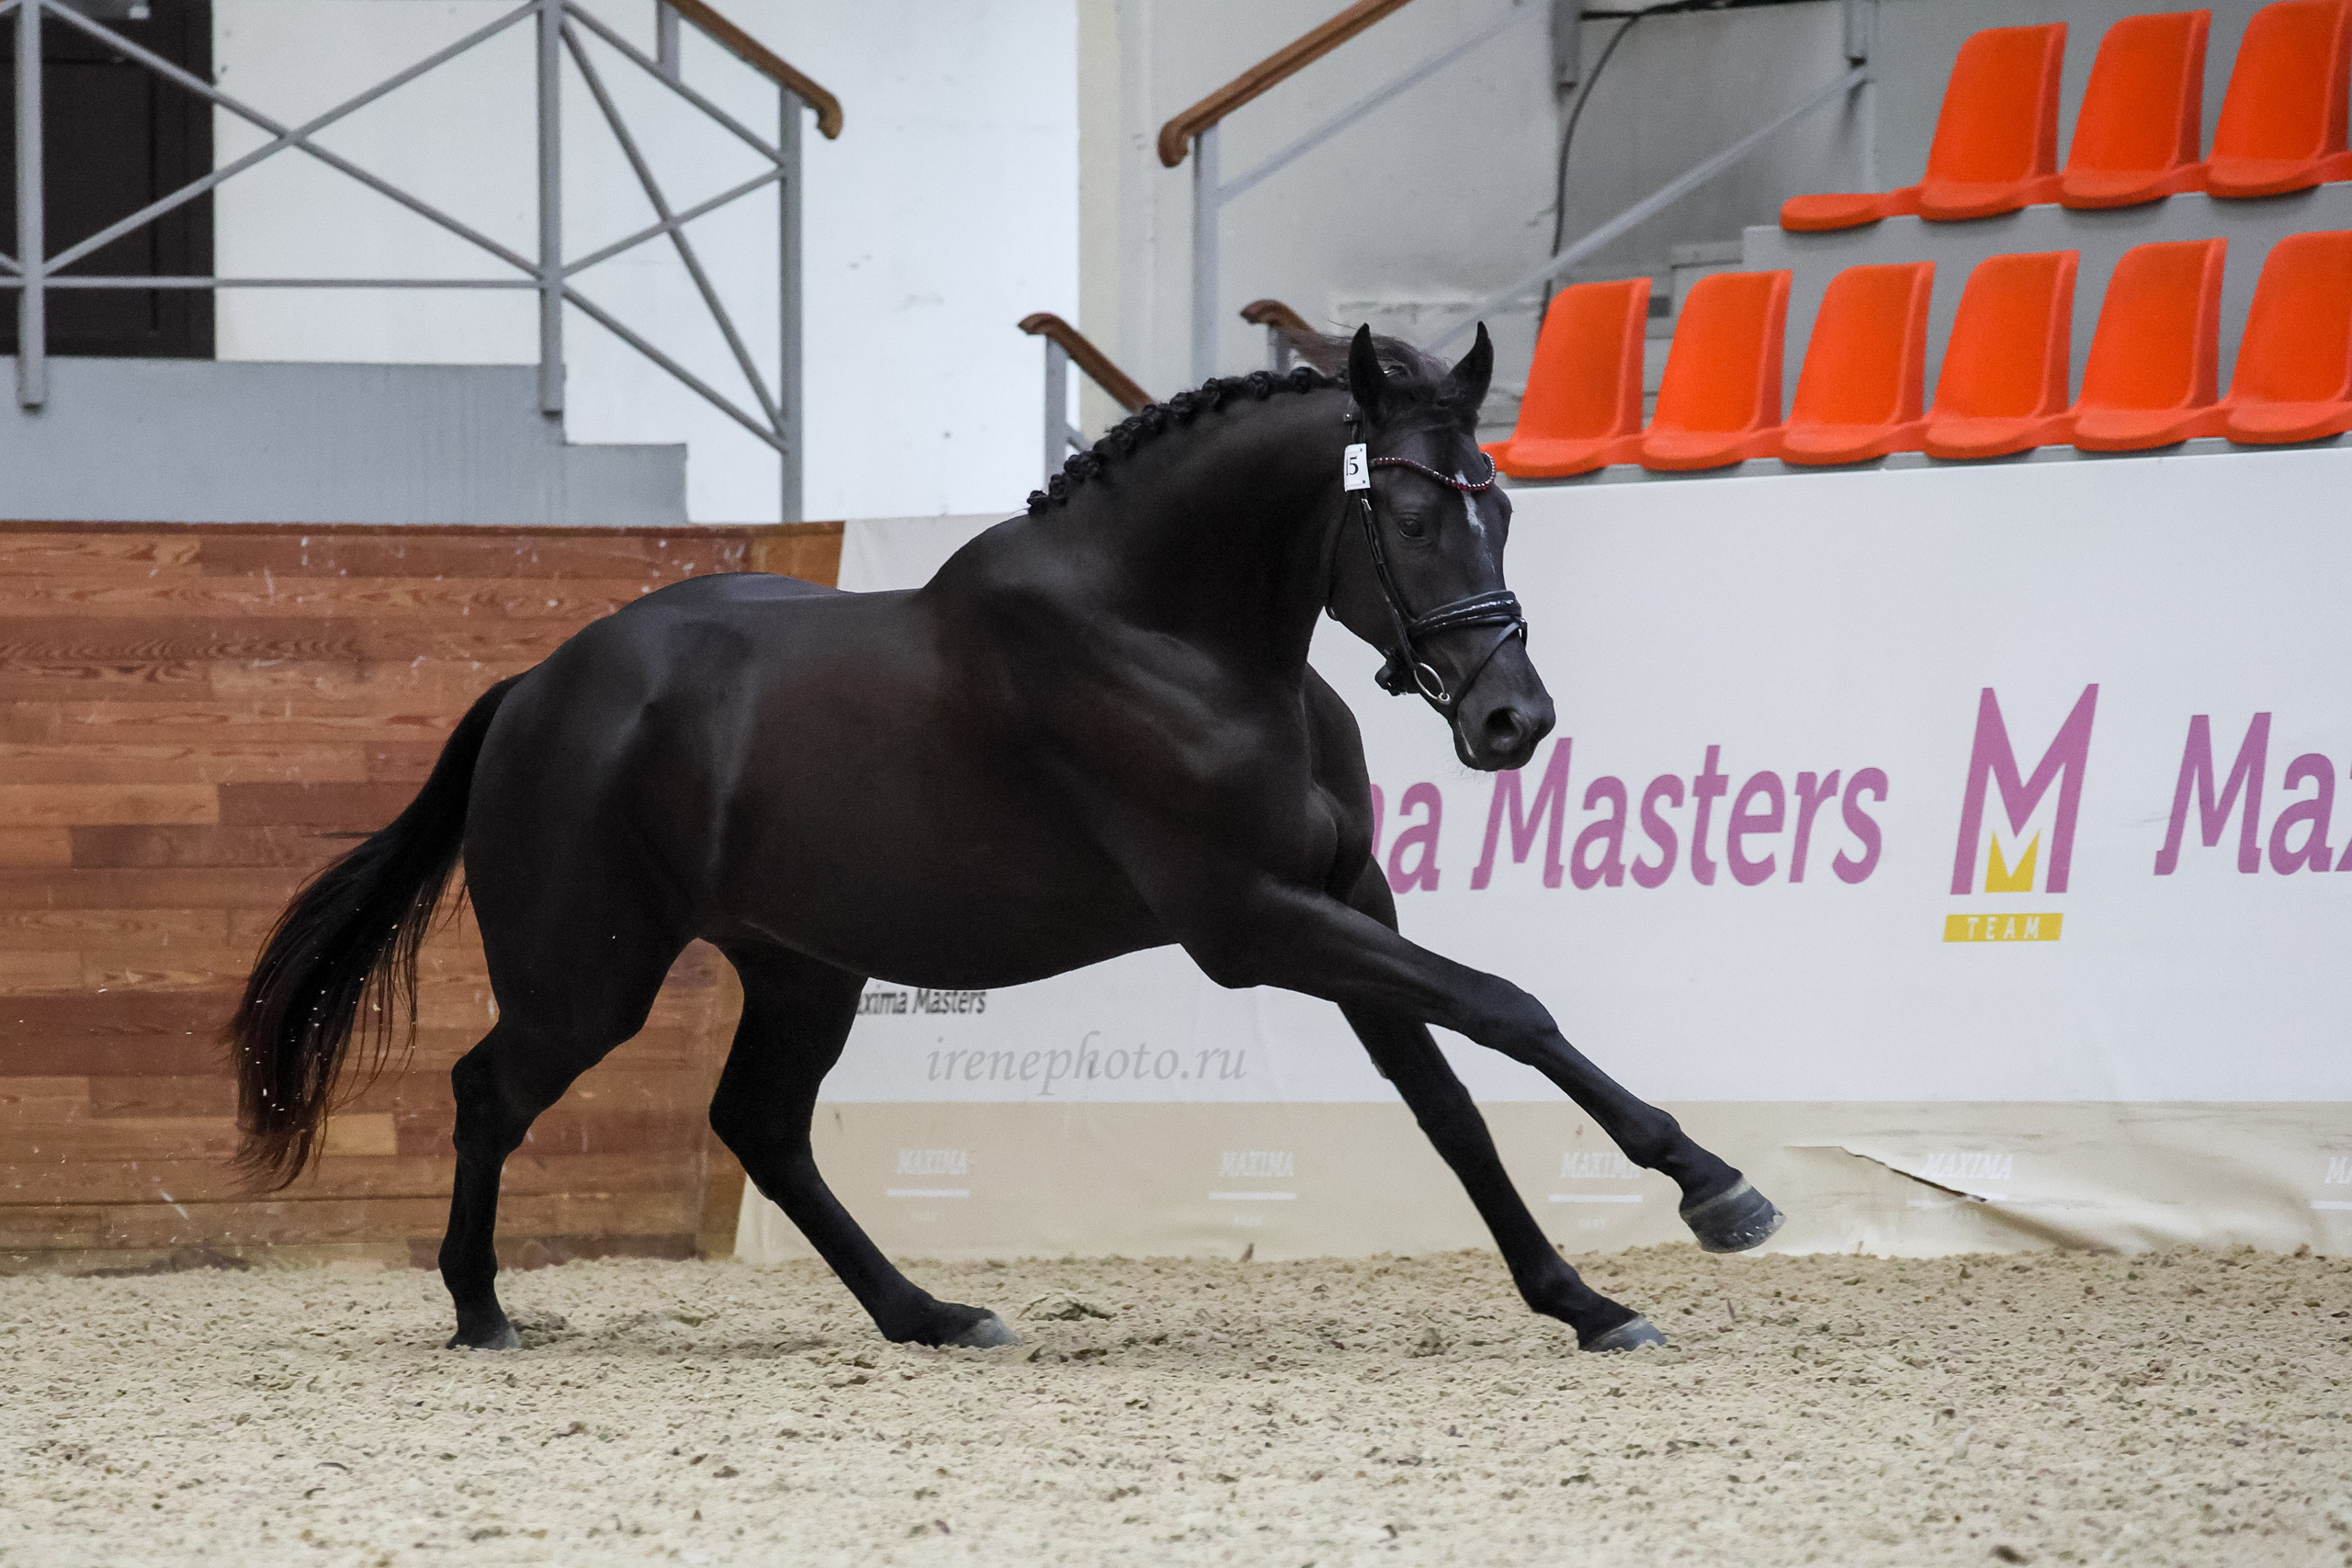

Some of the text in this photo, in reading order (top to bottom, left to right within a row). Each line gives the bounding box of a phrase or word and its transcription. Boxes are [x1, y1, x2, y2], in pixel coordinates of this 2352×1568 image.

[2153, 711, 2352, 876] Ma
[1470, 737, 1888, 891] Masters
[1967, 916, 2041, 941] TEAM
[911, 987, 987, 1015] Masters
[1917, 1152, 2014, 1180] MAXIMA
